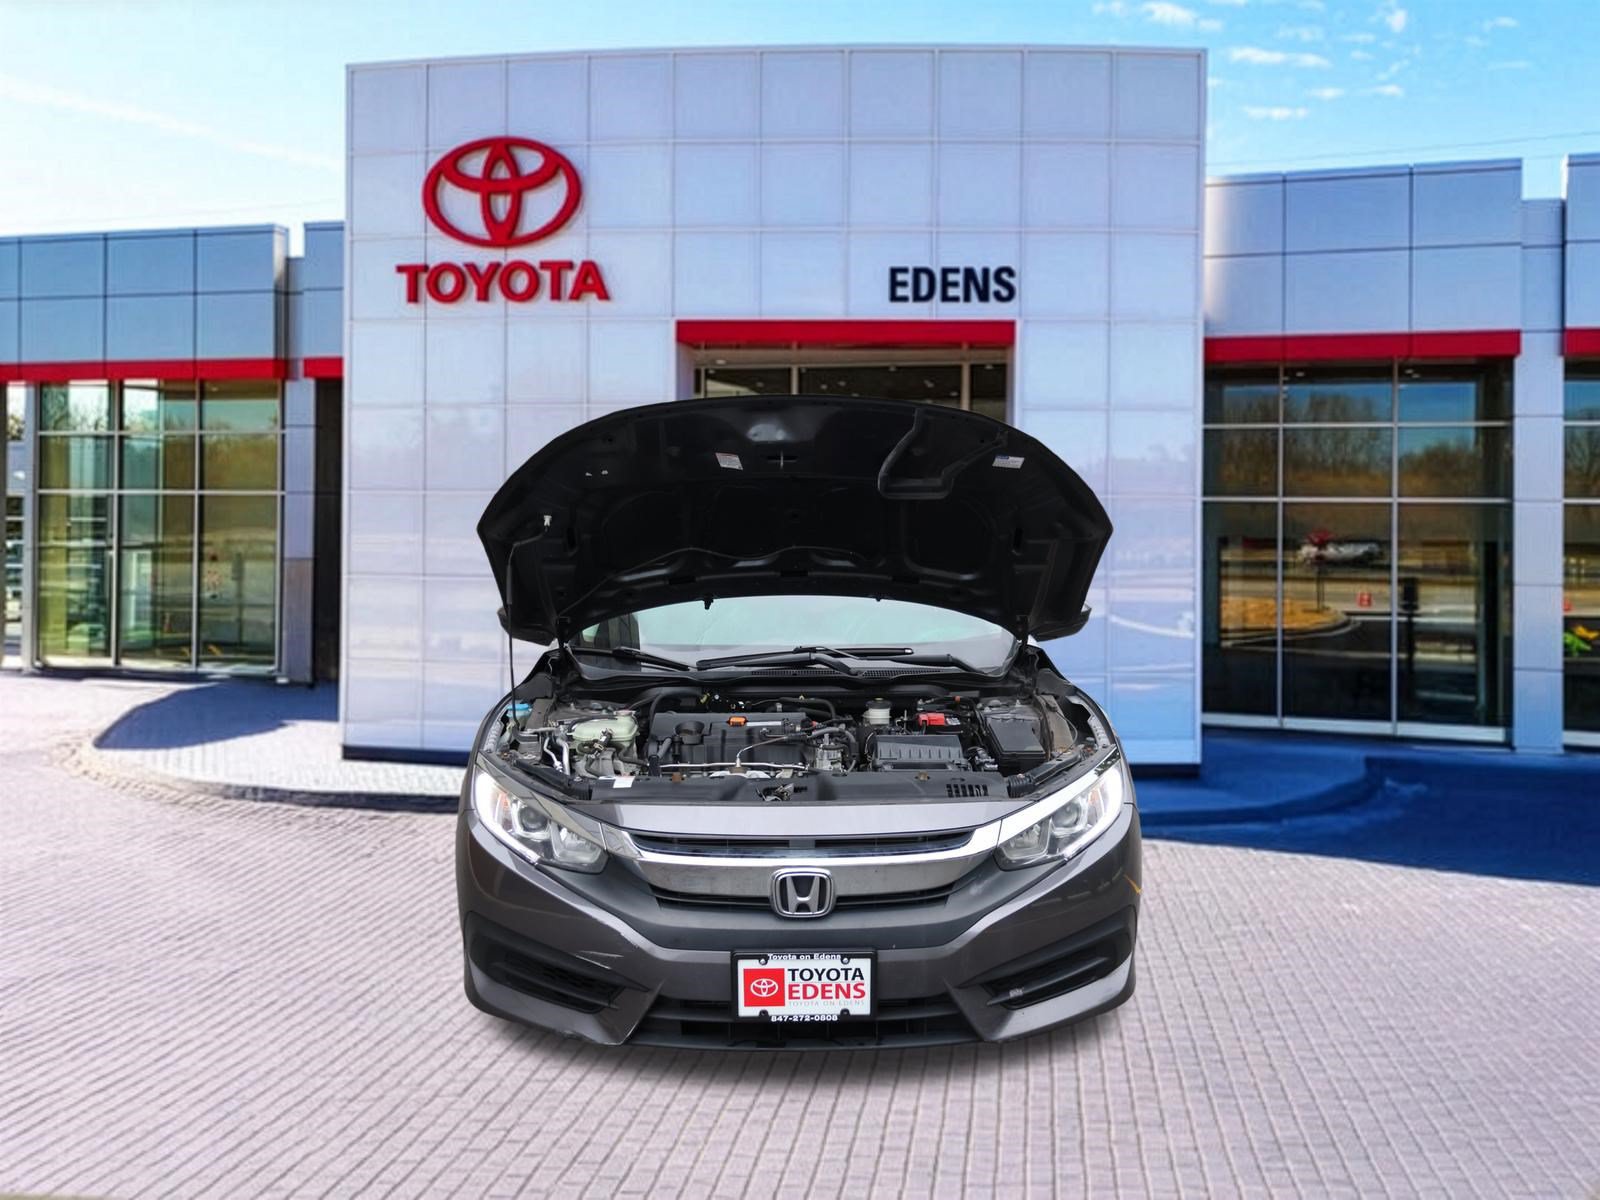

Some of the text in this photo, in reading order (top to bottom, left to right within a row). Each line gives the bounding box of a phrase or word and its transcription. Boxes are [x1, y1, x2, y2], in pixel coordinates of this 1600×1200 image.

[396, 260, 611, 304] TOYOTA
[889, 265, 1017, 303] EDENS
[767, 953, 798, 961] Toyota
[787, 968, 864, 982] TOYOTA
[788, 983, 866, 1000] EDENS
[771, 1014, 839, 1022] 847-272-0808
